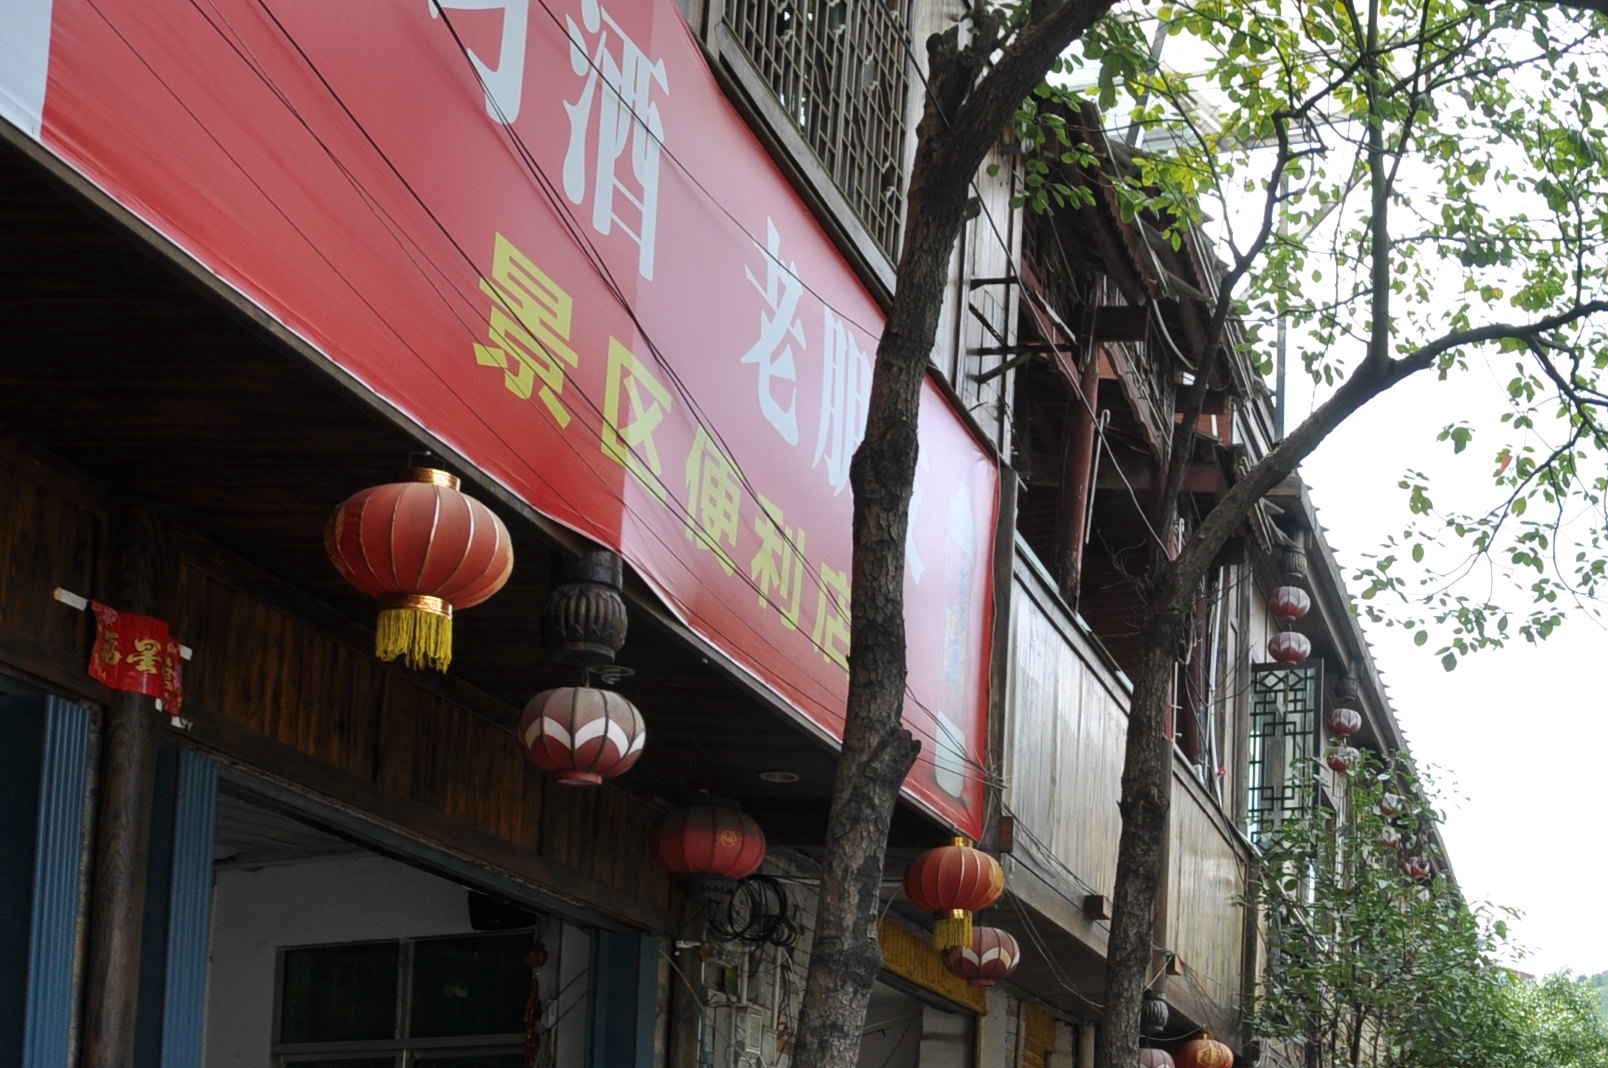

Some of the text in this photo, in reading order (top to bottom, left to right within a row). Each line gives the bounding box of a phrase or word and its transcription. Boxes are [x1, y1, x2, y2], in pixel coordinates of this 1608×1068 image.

[474, 231, 852, 664] 景区便利店
